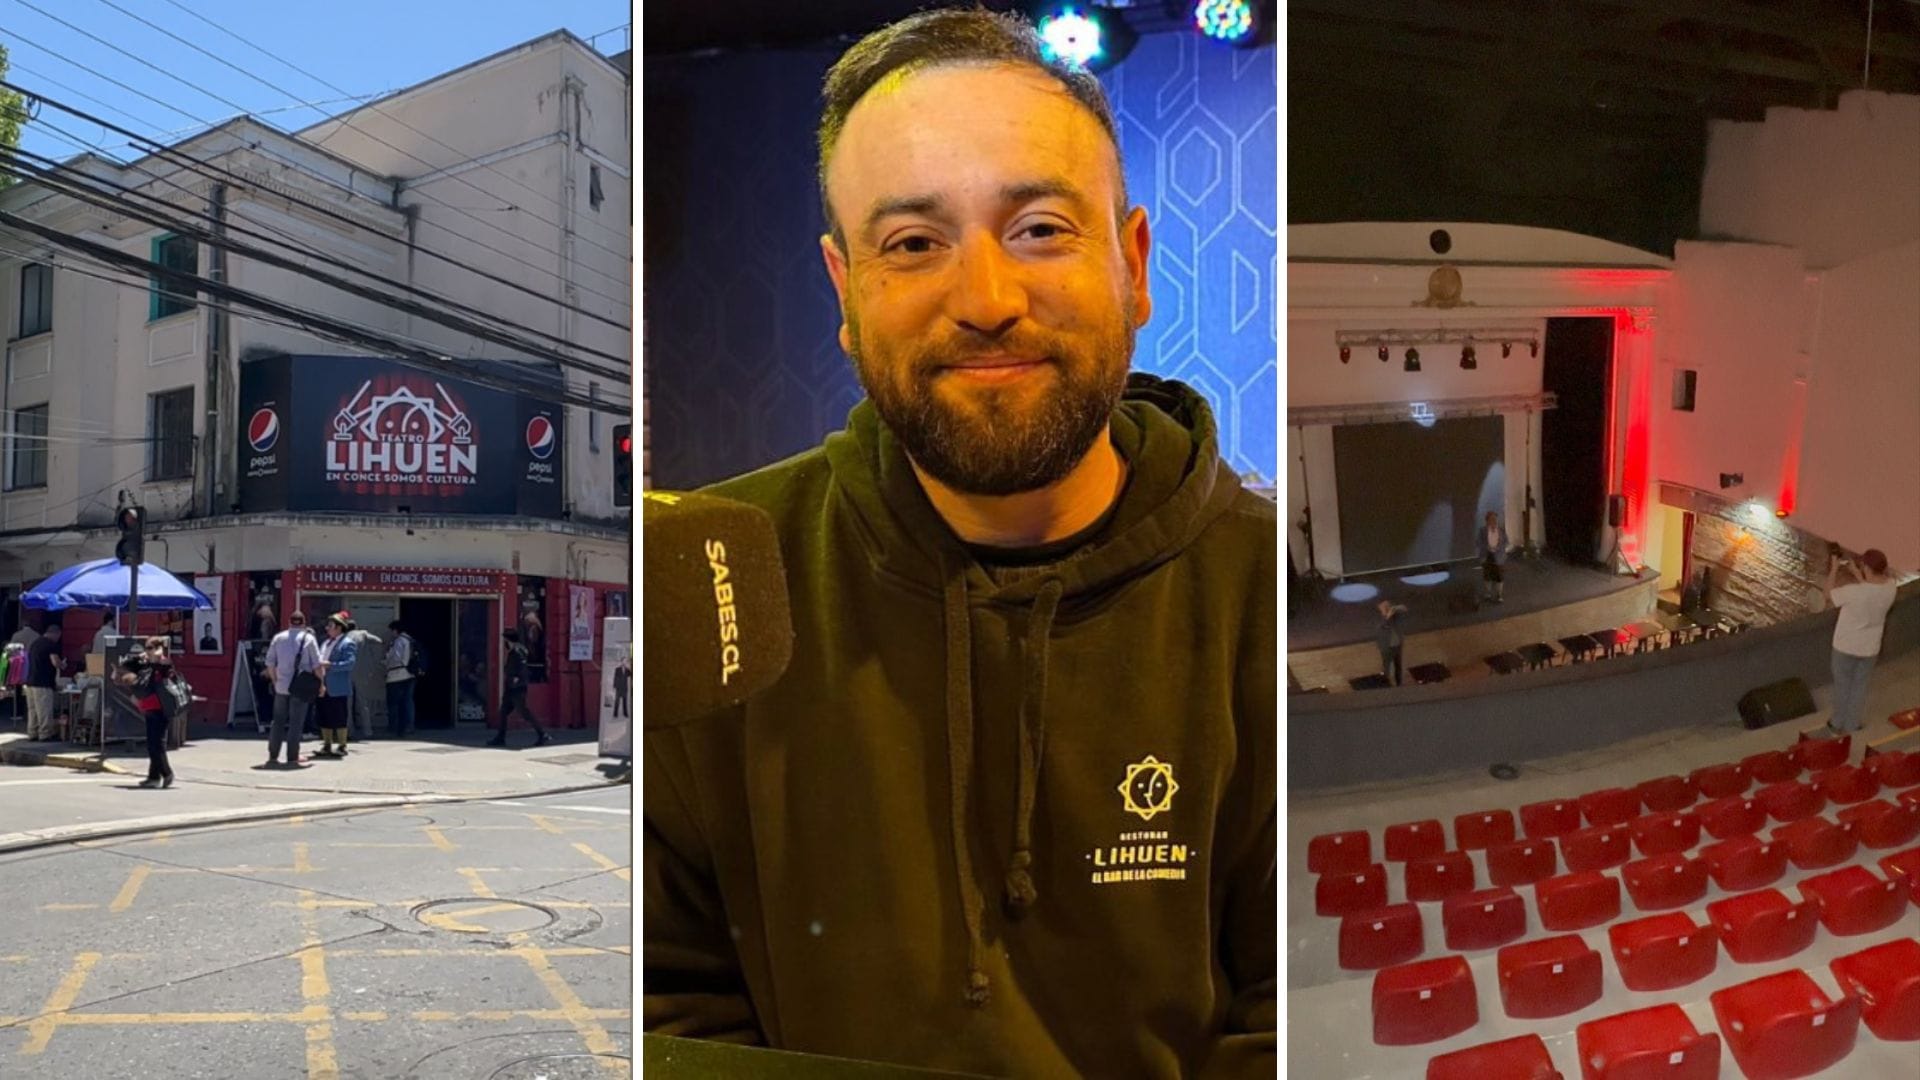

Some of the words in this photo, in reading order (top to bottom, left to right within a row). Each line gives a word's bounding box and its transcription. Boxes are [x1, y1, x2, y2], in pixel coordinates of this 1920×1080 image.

[380, 433, 425, 443] TEATRO
[250, 453, 276, 470] pepsi
[326, 441, 478, 474] LIHUEN
[326, 472, 341, 481] EN
[343, 473, 381, 482] CONCE
[384, 473, 424, 483] SOMOS
[426, 474, 477, 485] CULTURA
[311, 571, 363, 583] LIHUEN
[380, 573, 391, 583] EN
[422, 573, 451, 585] SOMOS
[453, 574, 489, 585] CULTURA
[1094, 844, 1187, 866] LIHUEN
[1134, 868, 1146, 880] LA
